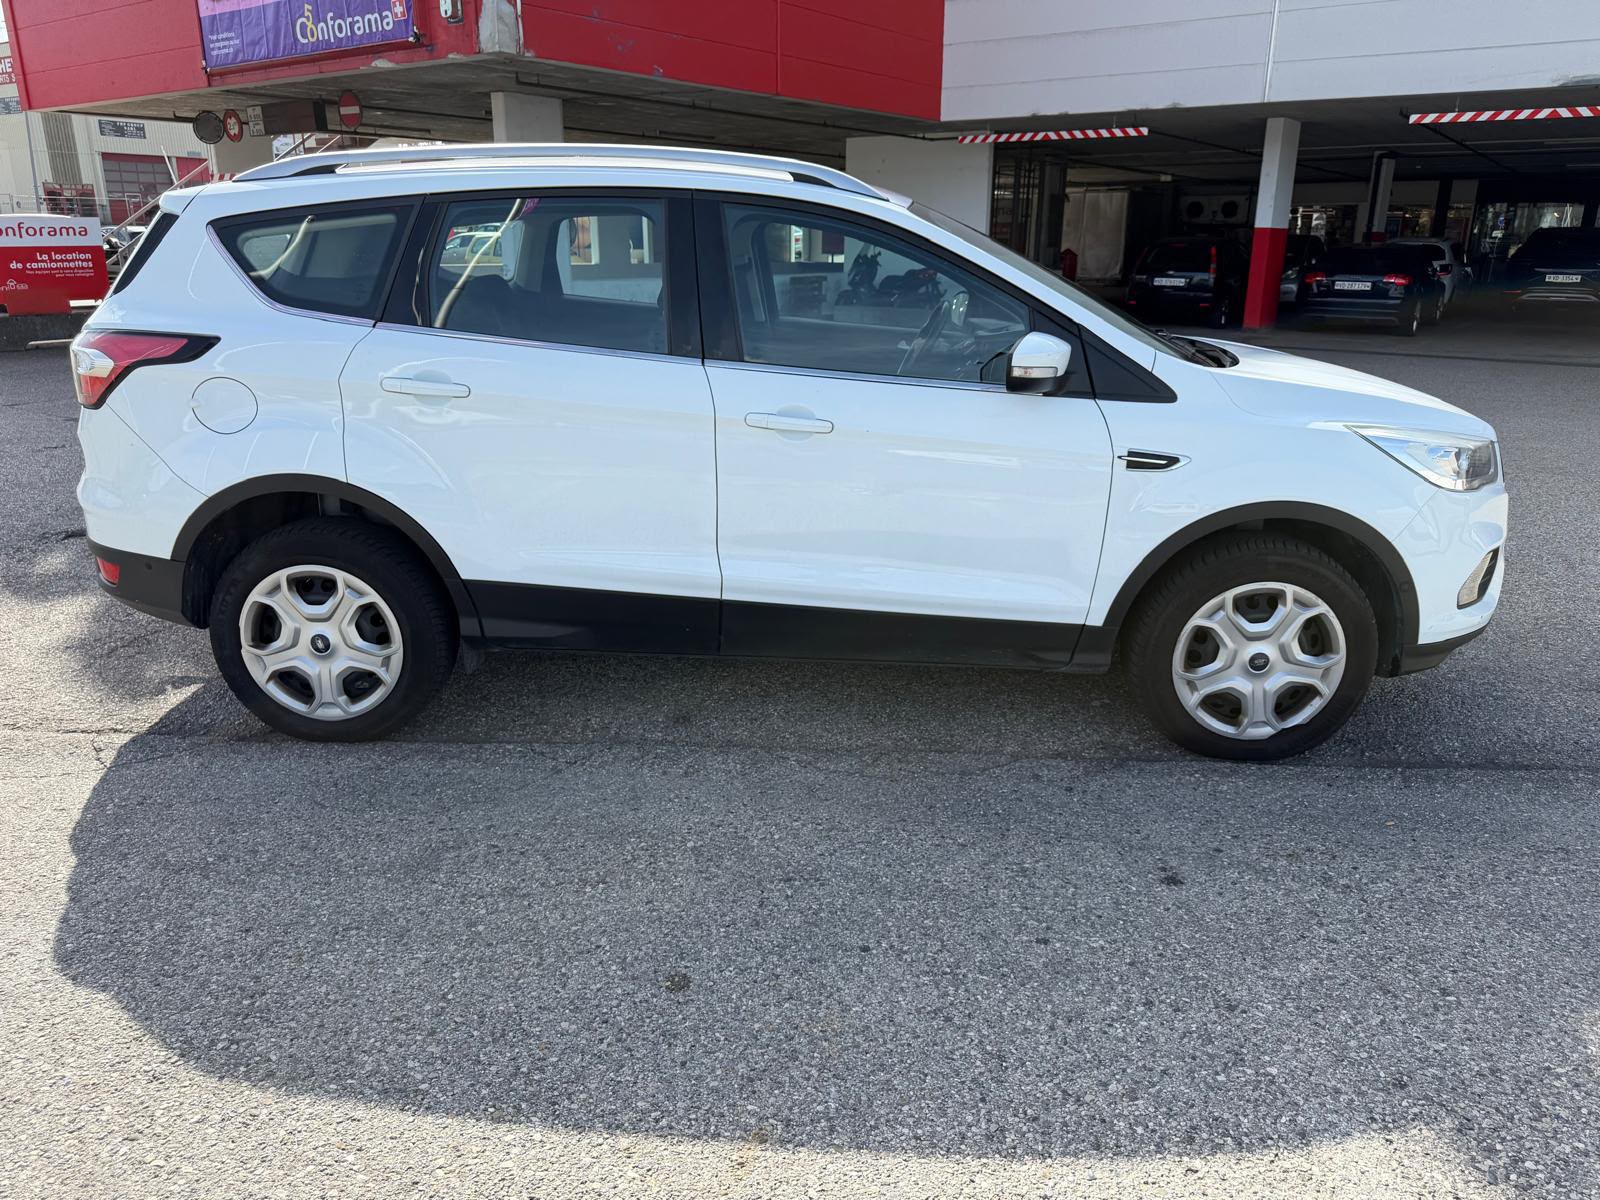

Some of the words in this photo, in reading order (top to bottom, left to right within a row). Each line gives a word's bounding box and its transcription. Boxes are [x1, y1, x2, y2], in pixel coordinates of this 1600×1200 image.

[36, 252, 49, 260] La
[52, 251, 92, 260] location
[10, 260, 23, 269] de
[26, 260, 93, 269] camionnettes
